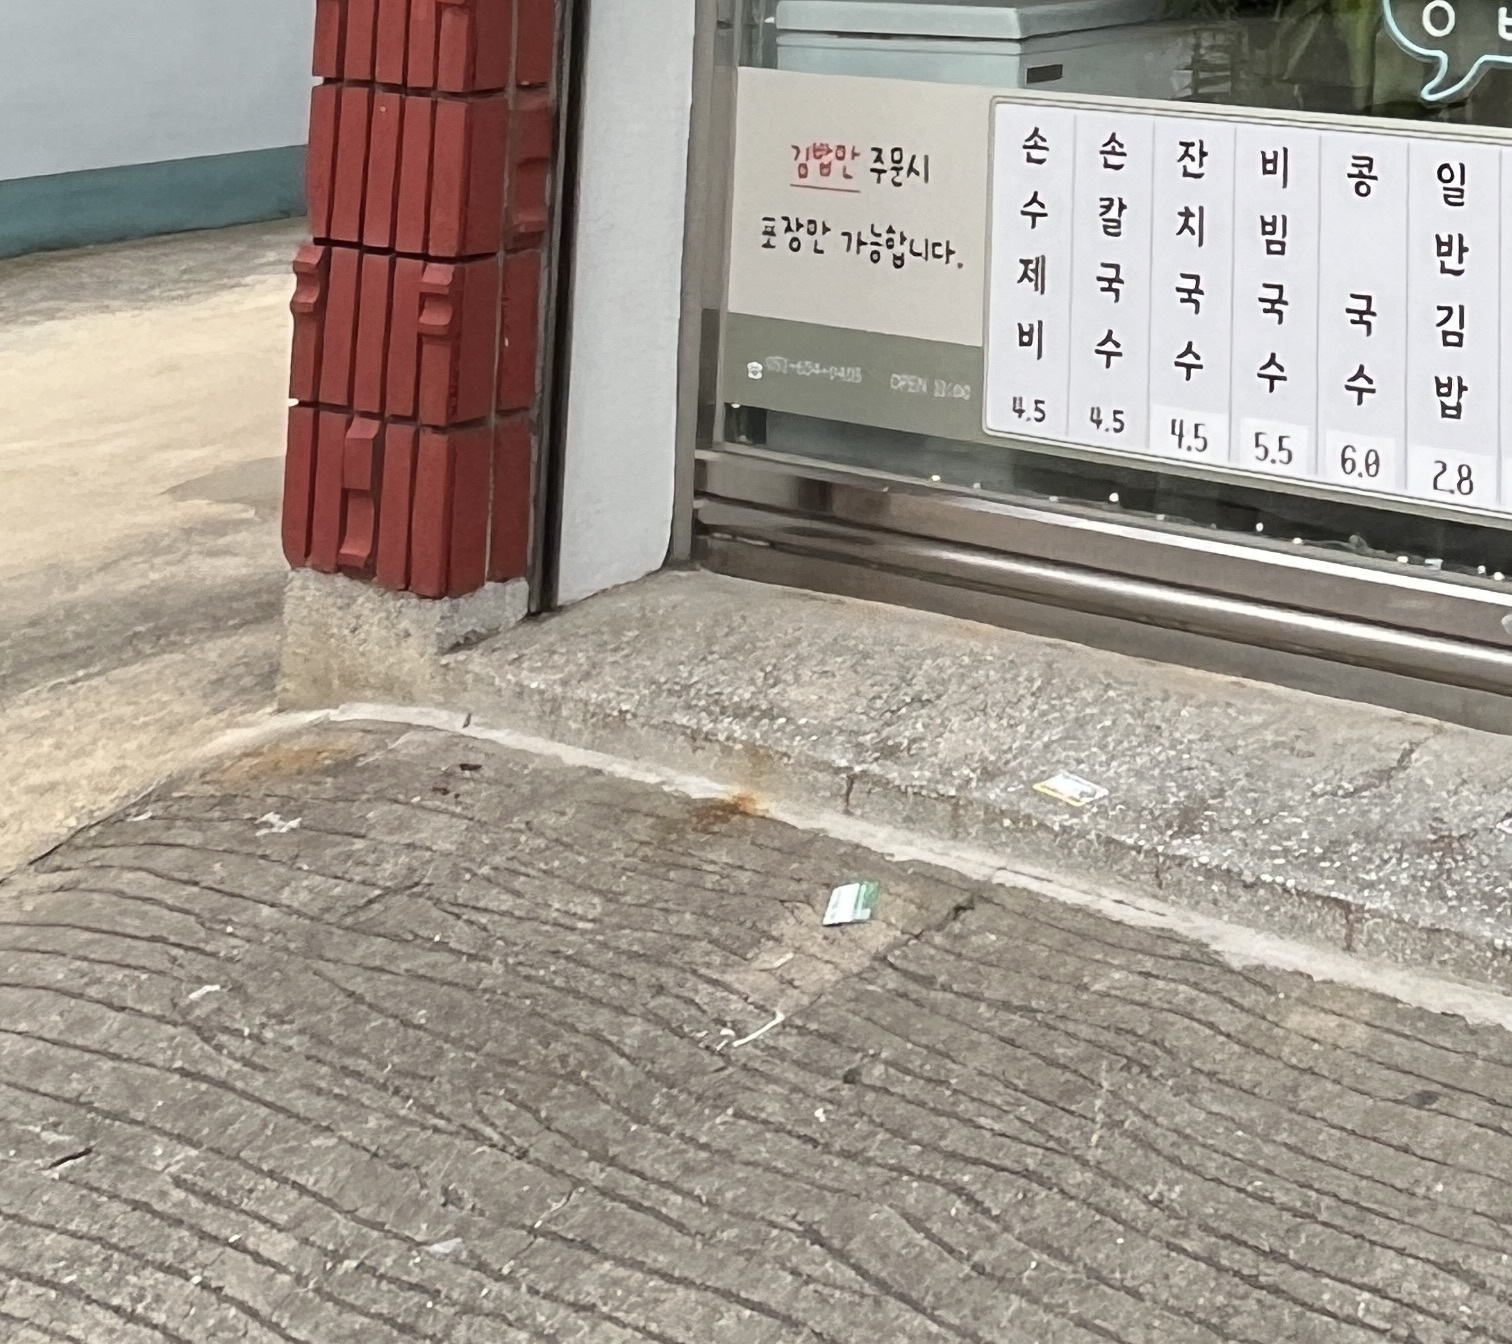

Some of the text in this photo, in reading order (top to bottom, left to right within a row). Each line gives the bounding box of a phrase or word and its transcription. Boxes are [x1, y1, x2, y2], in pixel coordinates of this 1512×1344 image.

[791, 142, 930, 187] 김밥만 주문시
[761, 215, 964, 270] 포장만 가능합니다.
[1016, 126, 1050, 361] 손수제비
[1094, 131, 1128, 370] 손칼국수
[1173, 139, 1209, 382] 잔치국수
[1256, 146, 1290, 394] 비빔국수
[1434, 162, 1470, 421] 일반김밥
[1011, 396, 1047, 422] 4.5
[1089, 407, 1125, 433] 4.5
[1170, 418, 1209, 452] 4.5
[1253, 431, 1294, 465] 5.5
[1340, 444, 1381, 479] 6.0
[1432, 460, 1475, 496] 2.8
